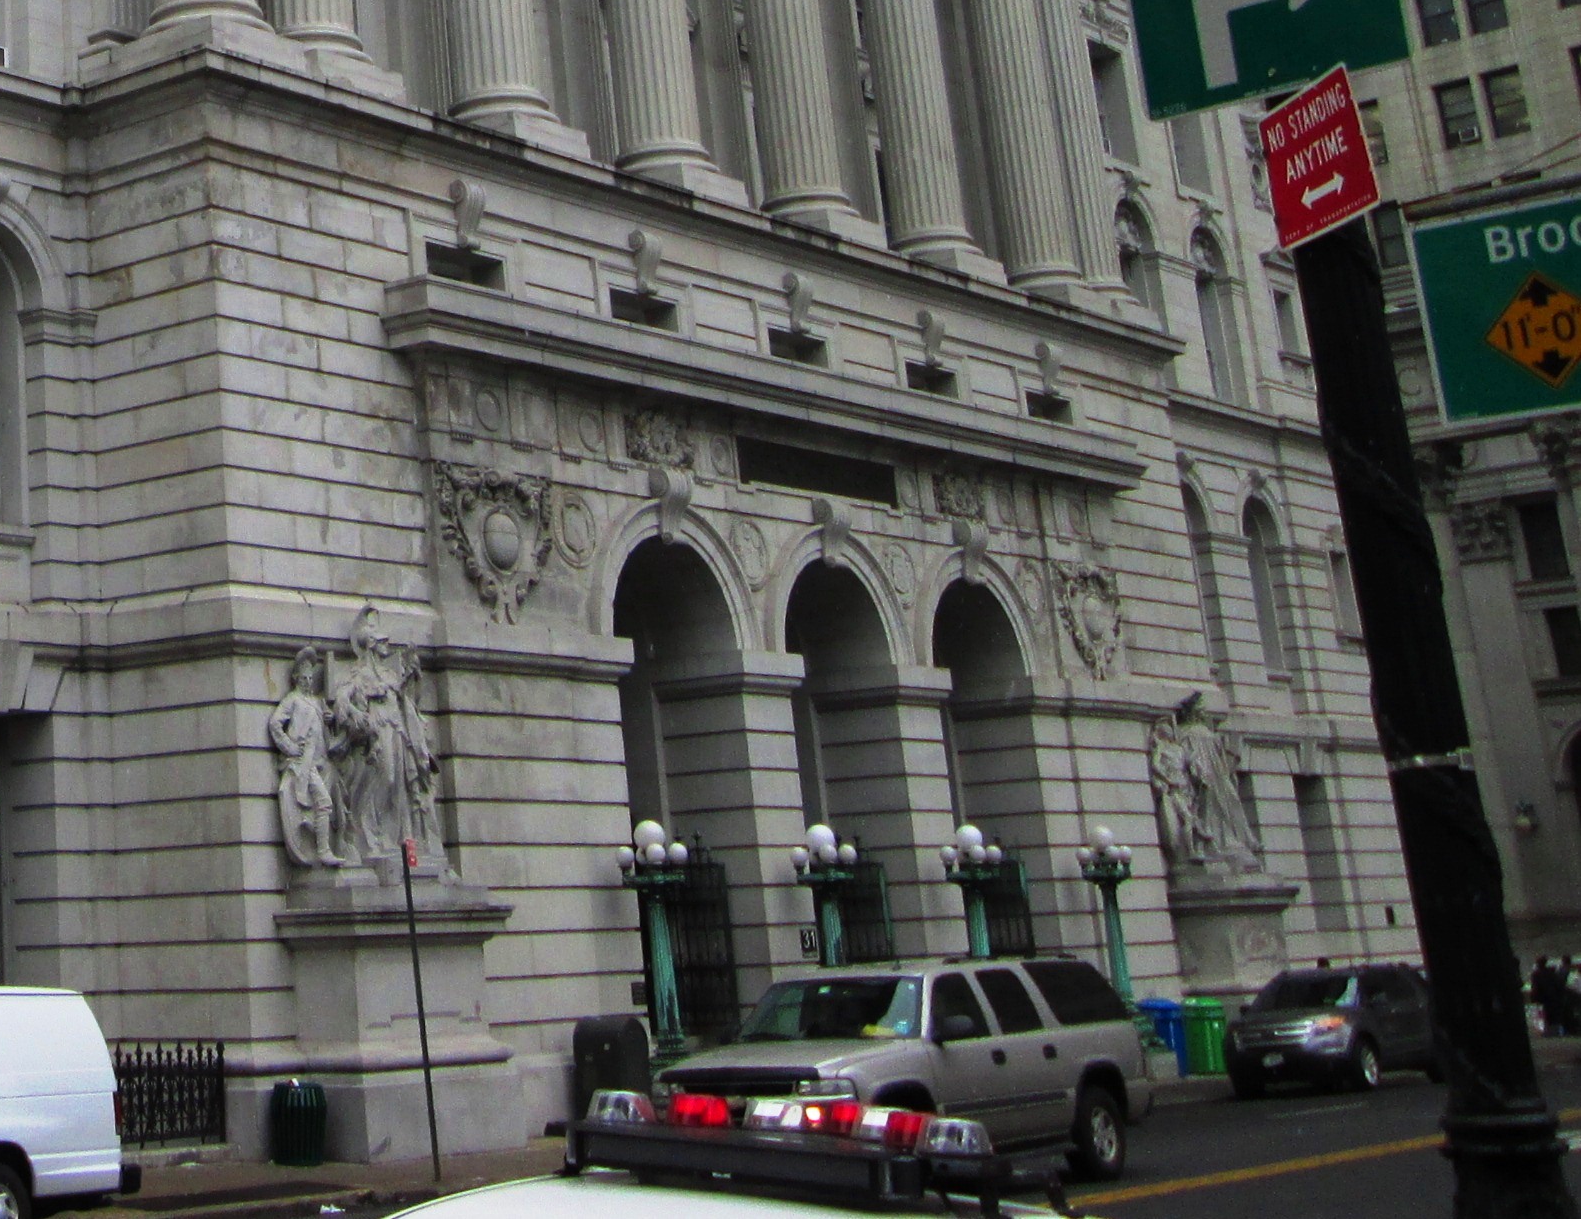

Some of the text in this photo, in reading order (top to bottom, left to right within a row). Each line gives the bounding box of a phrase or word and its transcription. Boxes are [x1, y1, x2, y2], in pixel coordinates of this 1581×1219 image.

[1266, 84, 1346, 153] NO STANDING
[1286, 126, 1348, 184] ANYTIME
[802, 929, 816, 949] 31
